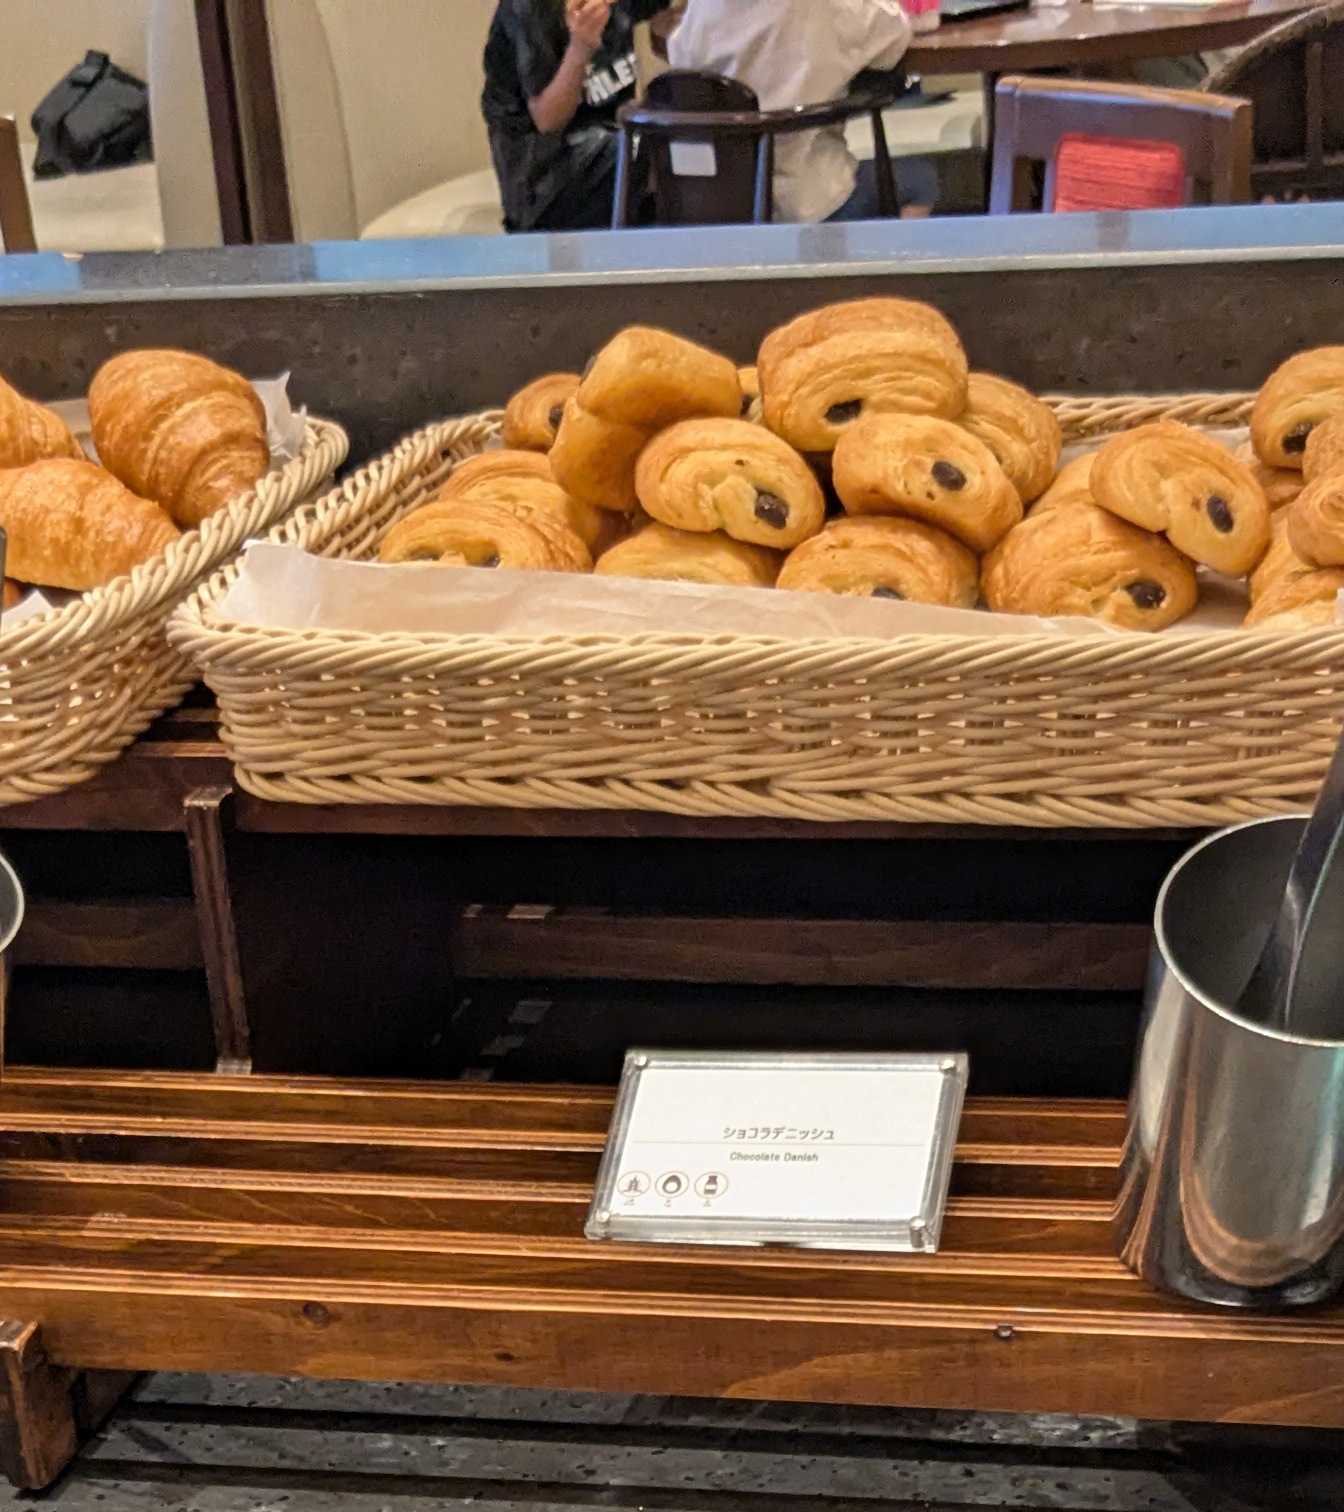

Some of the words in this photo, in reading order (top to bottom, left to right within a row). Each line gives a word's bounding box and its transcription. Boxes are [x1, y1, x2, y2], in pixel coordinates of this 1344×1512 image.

[721, 1126, 835, 1141] ショコラデニッシュ
[729, 1151, 781, 1162] Chocolate
[783, 1151, 819, 1162] Danish
